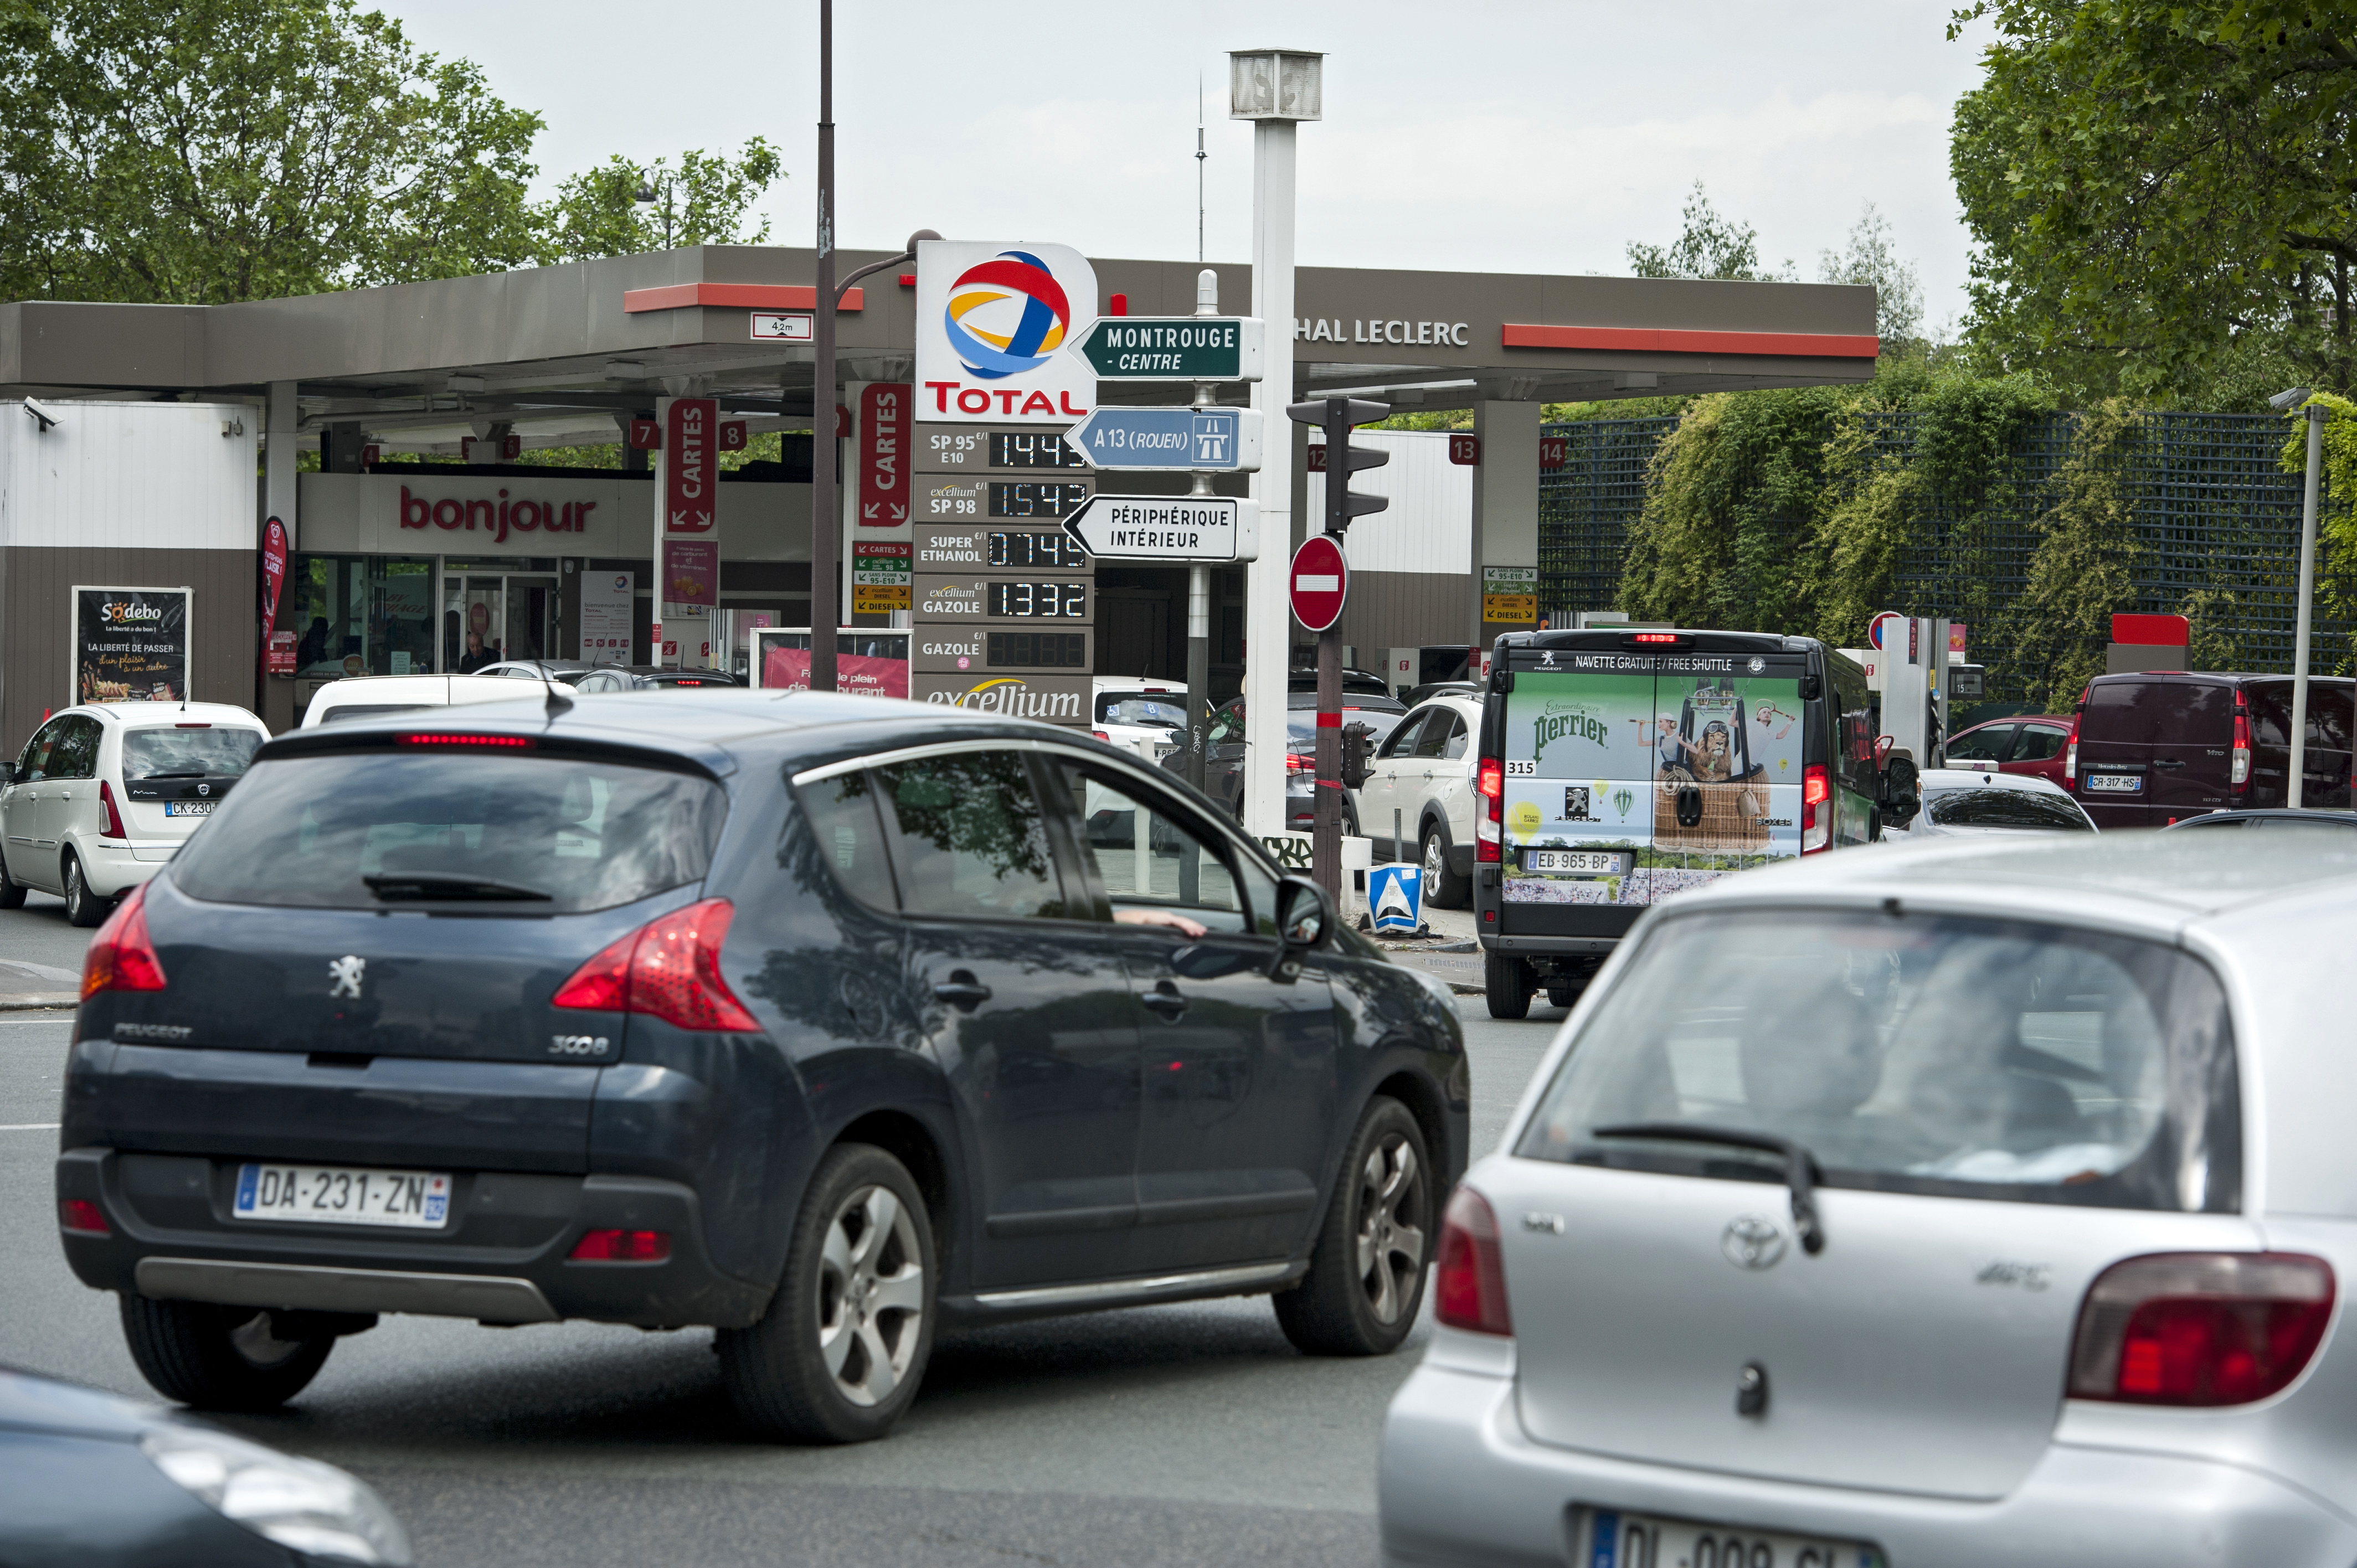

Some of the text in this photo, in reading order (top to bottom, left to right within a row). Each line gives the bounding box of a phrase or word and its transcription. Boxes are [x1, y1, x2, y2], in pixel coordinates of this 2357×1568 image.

[1107, 328, 1234, 348] MONTROUGE
[1355, 319, 1469, 347] LECLERC
[1119, 354, 1182, 370] CENTRE
[925, 381, 1088, 415] TOTAL
[639, 426, 650, 443] 7
[727, 427, 739, 445] 8
[876, 392, 897, 490] CARTES
[930, 435, 951, 450] SP
[955, 436, 975, 450] 95
[1094, 429, 1188, 451] A 13 (ROUEN)
[367, 449, 373, 460] 4
[508, 443, 514, 454] 6
[682, 407, 702, 498] CARTES
[1454, 441, 1474, 460] 13
[1541, 443, 1563, 462] 14
[1309, 450, 1326, 467] 12
[930, 485, 976, 498] excellium
[400, 485, 596, 544] bonjour
[930, 499, 976, 514] SP 98
[1111, 505, 1228, 526] PÉRIPHÉRIQUE
[930, 536, 972, 548] SUPER
[1110, 529, 1198, 548] INTÉRIEUR
[920, 550, 981, 562] ETHANOL
[929, 586, 975, 599] excellium
[1002, 584, 1084, 616] 1.332
[101, 602, 161, 622] Sodebo
[923, 601, 980, 613] GAZOLE
[100, 642, 130, 652] LIBERTÉ
[922, 643, 980, 656] GAZOLE
[99, 653, 146, 668] d'un plaisir
[146, 661, 168, 671] autre
[1576, 655, 1615, 669] NAVETTE
[1617, 656, 1660, 670] GRATUITE
[1668, 658, 1690, 670] FREE
[1692, 658, 1732, 671] SHUTTLE
[788, 682, 807, 691] de
[850, 674, 877, 684] plein
[1957, 684, 1964, 693] 15
[927, 684, 1080, 718] excellium
[1147, 704, 1156, 714] B
[1546, 699, 1603, 715] Extraordinaire
[1507, 762, 1534, 775] 315
[2093, 777, 2135, 788] CR-317-HS
[1756, 818, 1792, 827] BOXER
[1538, 853, 1609, 869] EB-965-BP
[114, 1022, 193, 1040] PEUGEOT
[547, 1034, 610, 1056] 3008
[260, 1169, 426, 1216] DA-231-ZN
